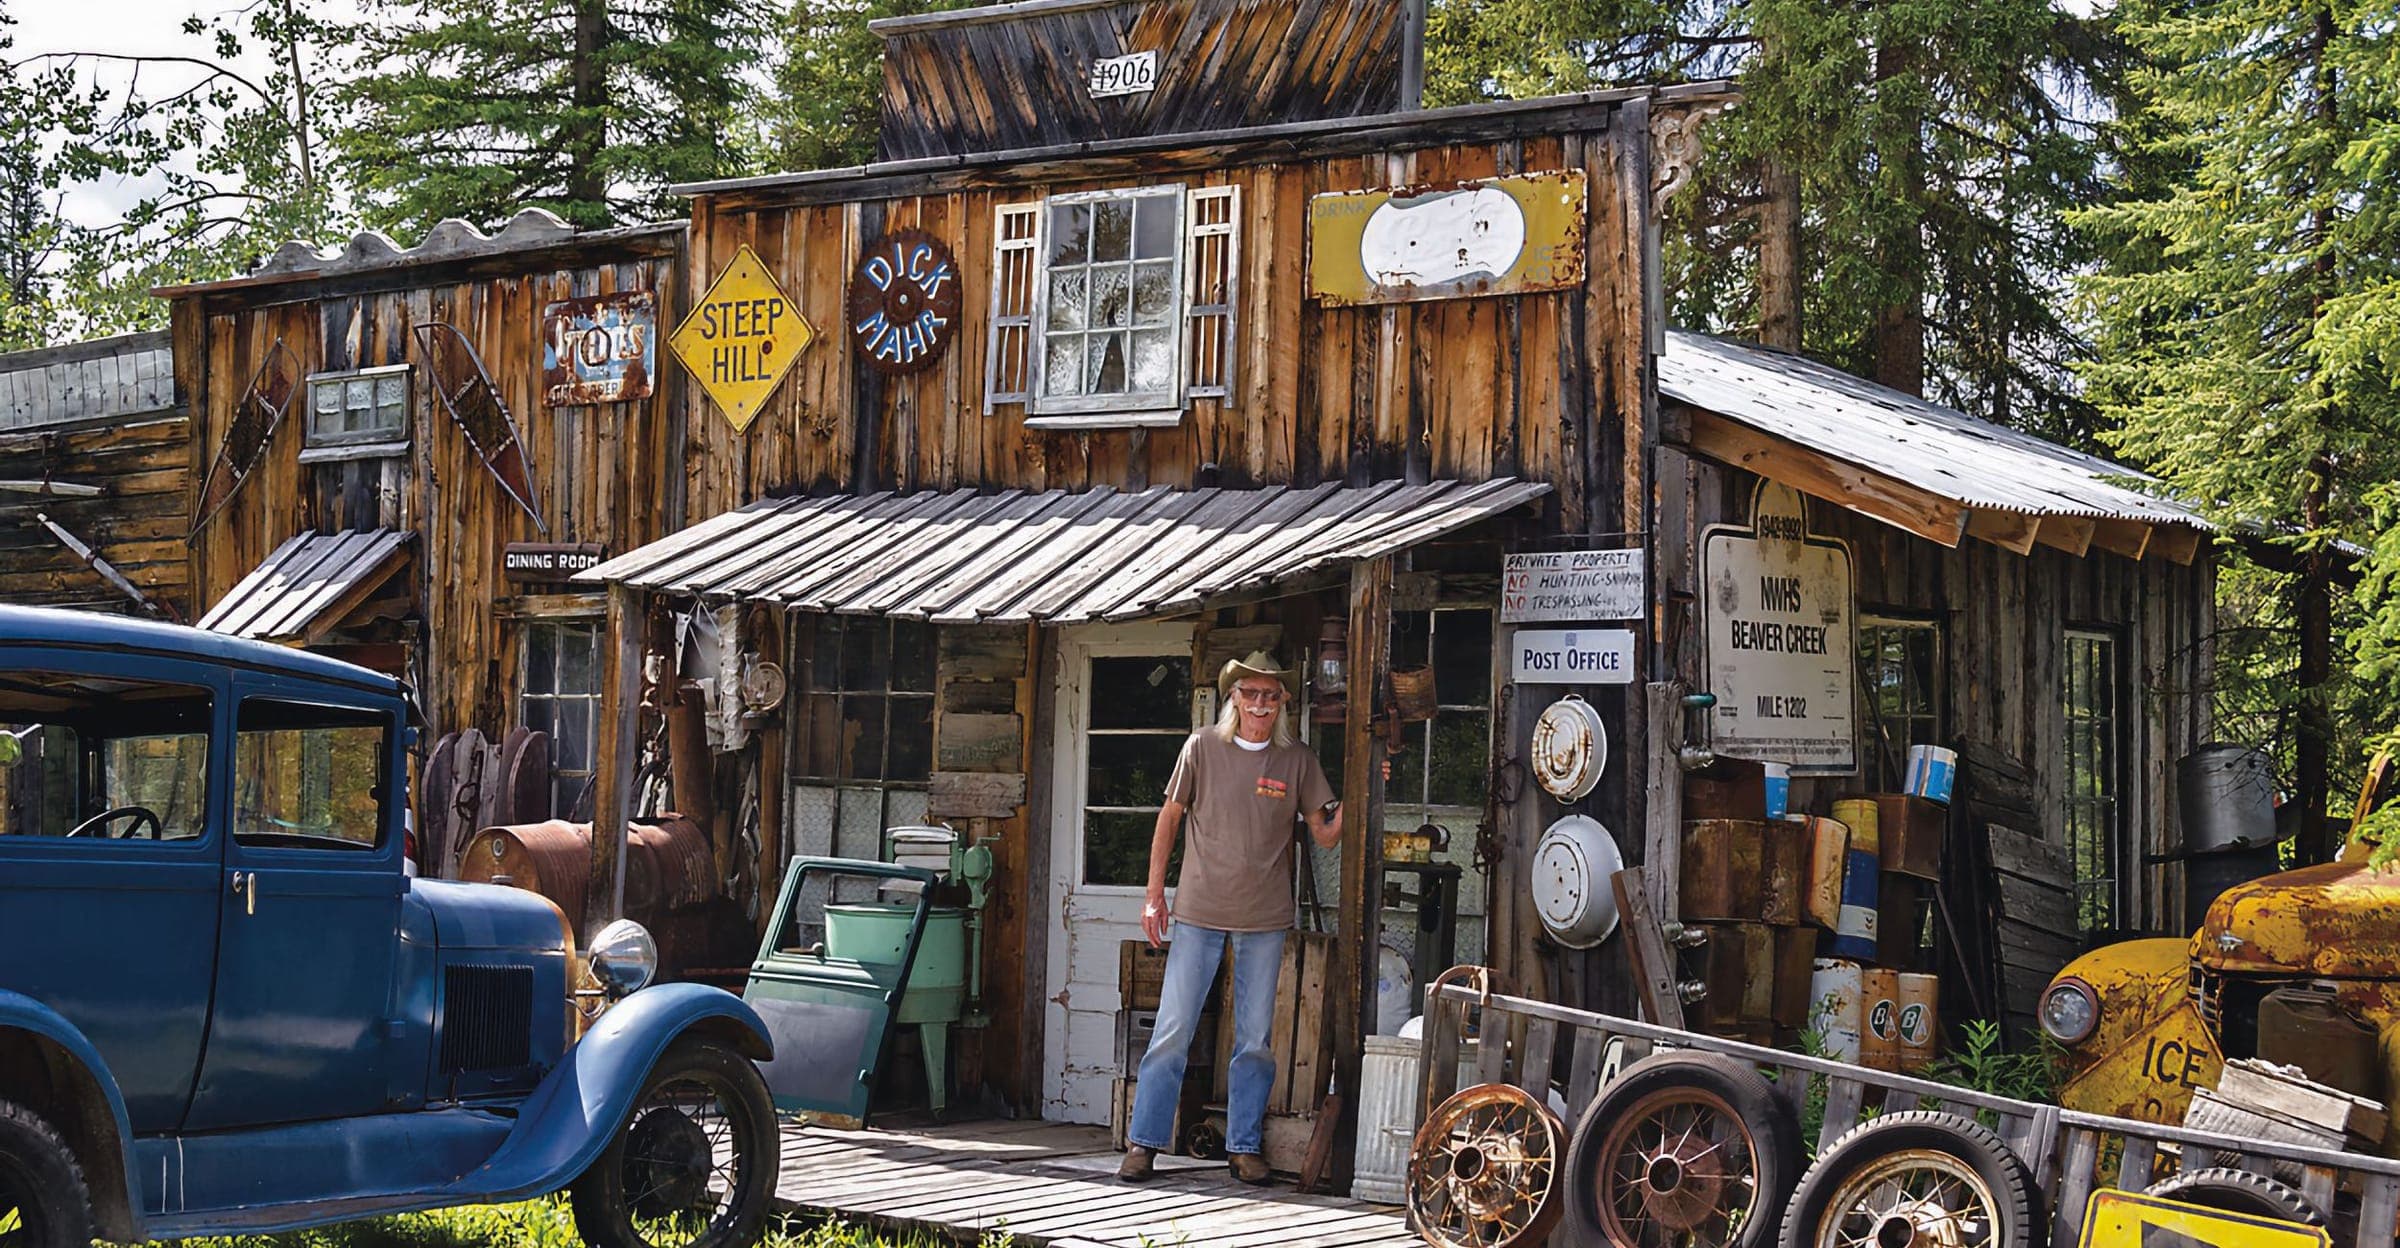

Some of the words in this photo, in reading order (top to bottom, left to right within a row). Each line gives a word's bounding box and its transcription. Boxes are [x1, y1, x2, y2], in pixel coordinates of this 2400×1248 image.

[1100, 59, 1150, 90] 1906
[1315, 201, 1366, 219] DRINK
[864, 242, 952, 300] DICK
[701, 298, 784, 340] STEEP
[856, 309, 948, 363] MAHR
[712, 345, 772, 384] HILL
[507, 554, 553, 569] DINING
[559, 554, 600, 569] ROOM
[1506, 554, 1562, 569] PRIVATE
[1572, 552, 1631, 567] PROPERTY
[1507, 574, 1530, 589] NO
[1760, 575, 1801, 613] NWHS
[1505, 595, 1527, 611] NO
[1731, 619, 1784, 652] BEAVER
[1786, 623, 1827, 655] CREEK
[1757, 695, 1783, 718] MILE
[1784, 697, 1807, 719] 1202
[2141, 1036, 2208, 1089] ICE
